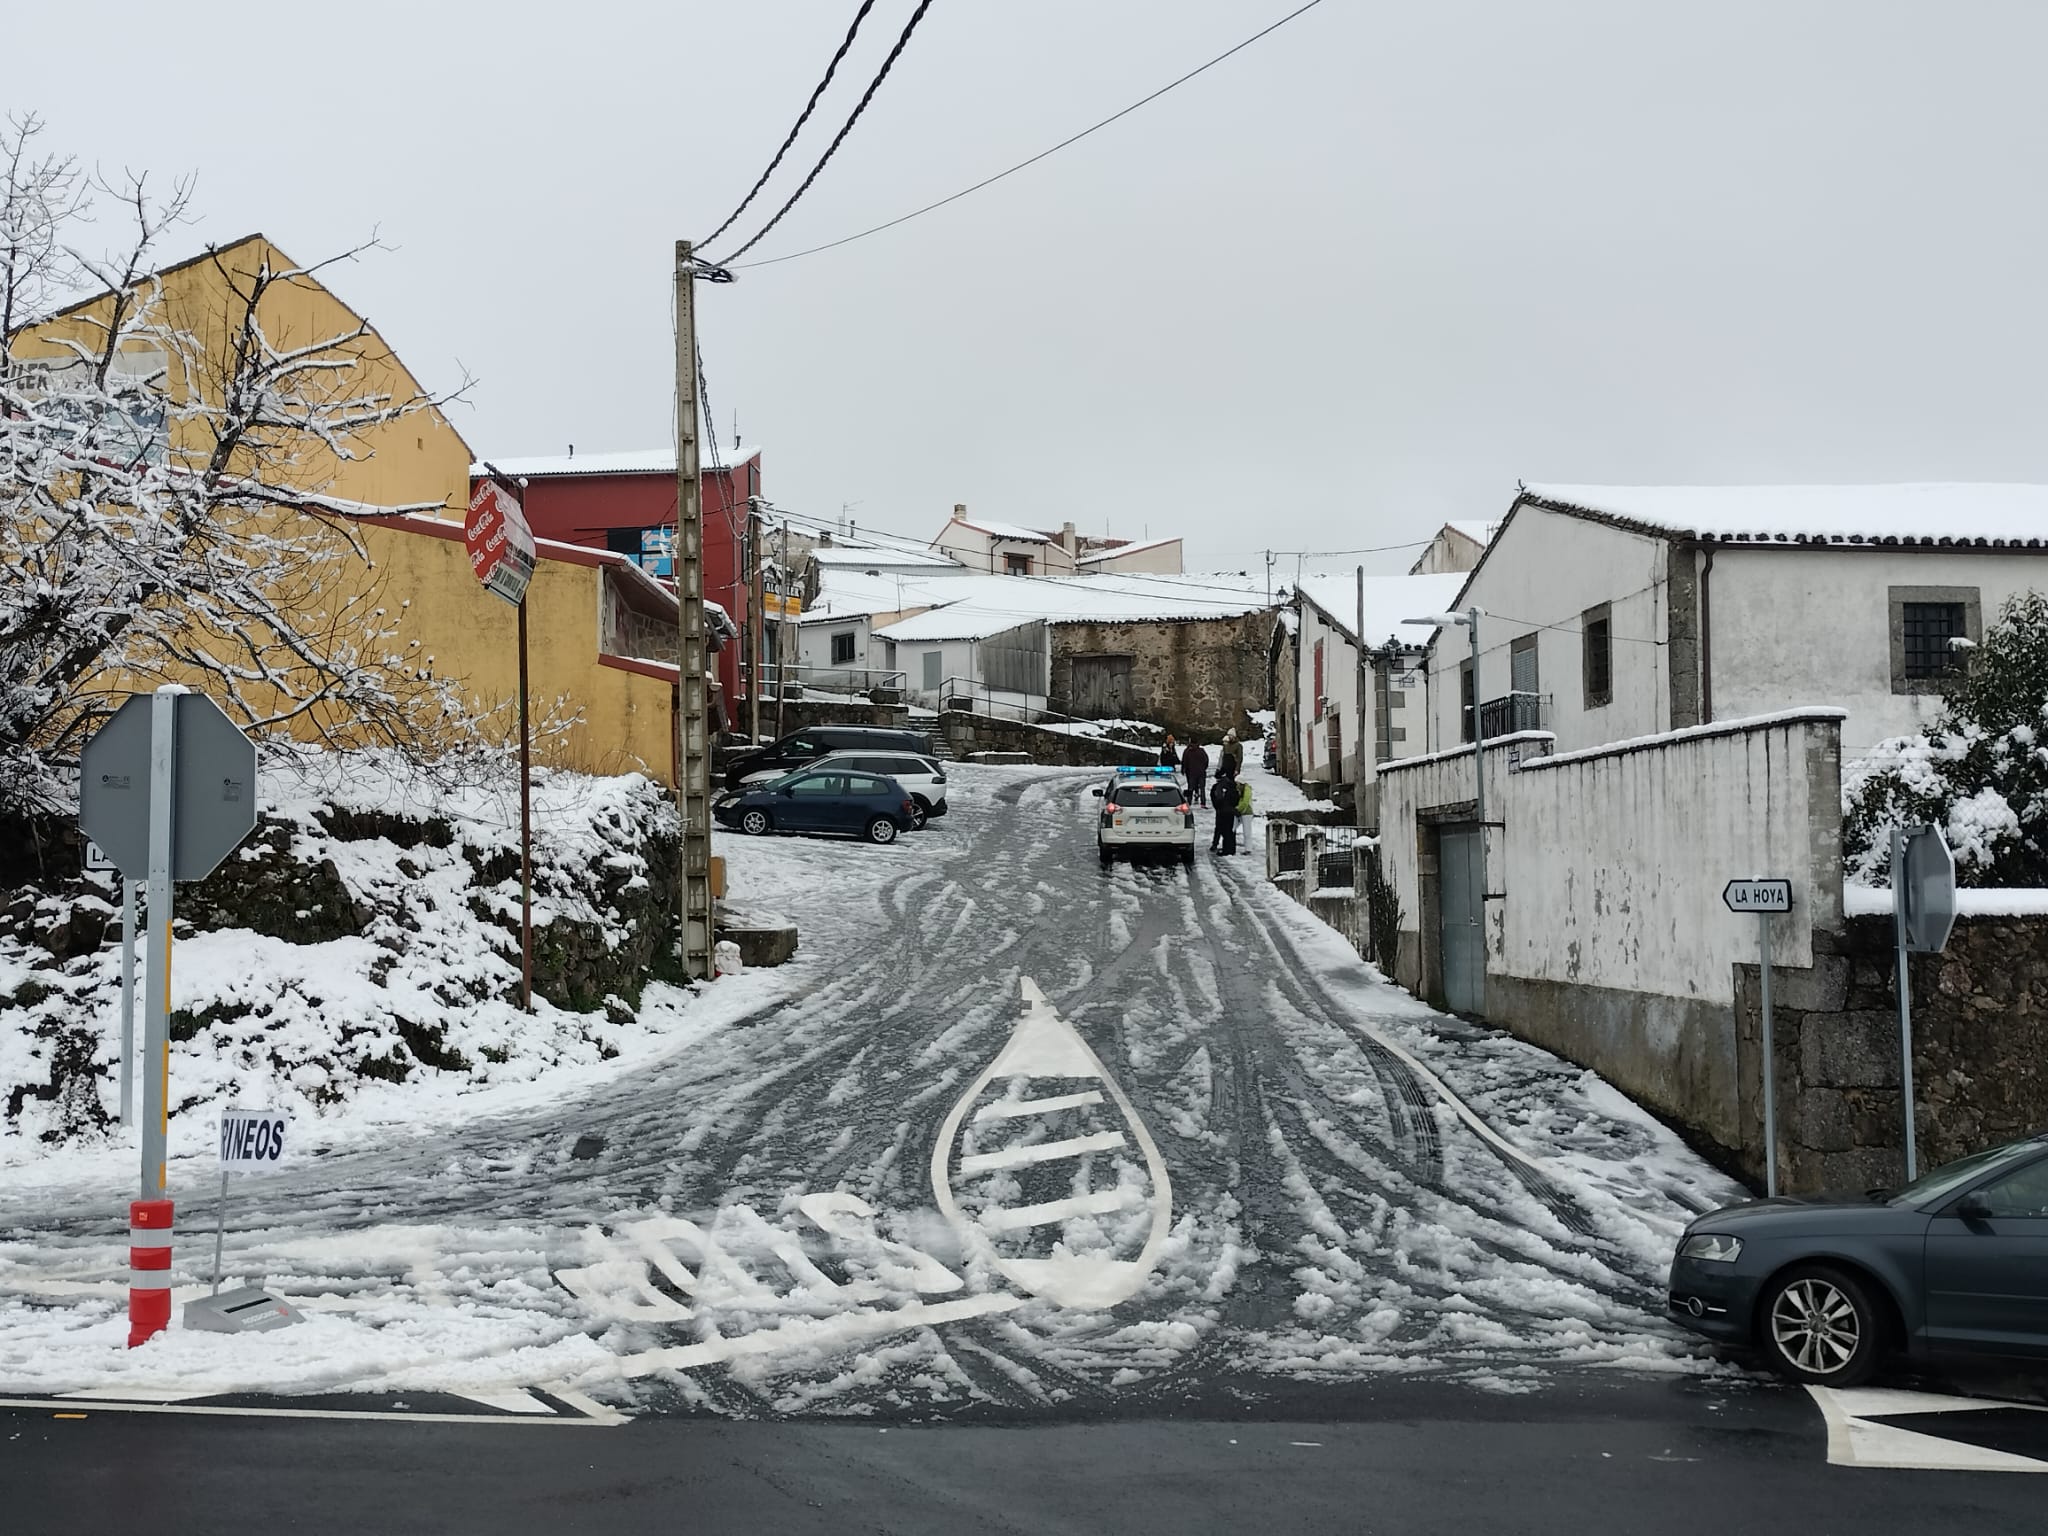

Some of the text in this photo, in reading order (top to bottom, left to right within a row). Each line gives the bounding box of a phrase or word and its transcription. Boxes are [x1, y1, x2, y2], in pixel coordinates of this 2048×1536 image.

[765, 582, 800, 597] ALQLER
[1735, 888, 1784, 903] LA HOYA
